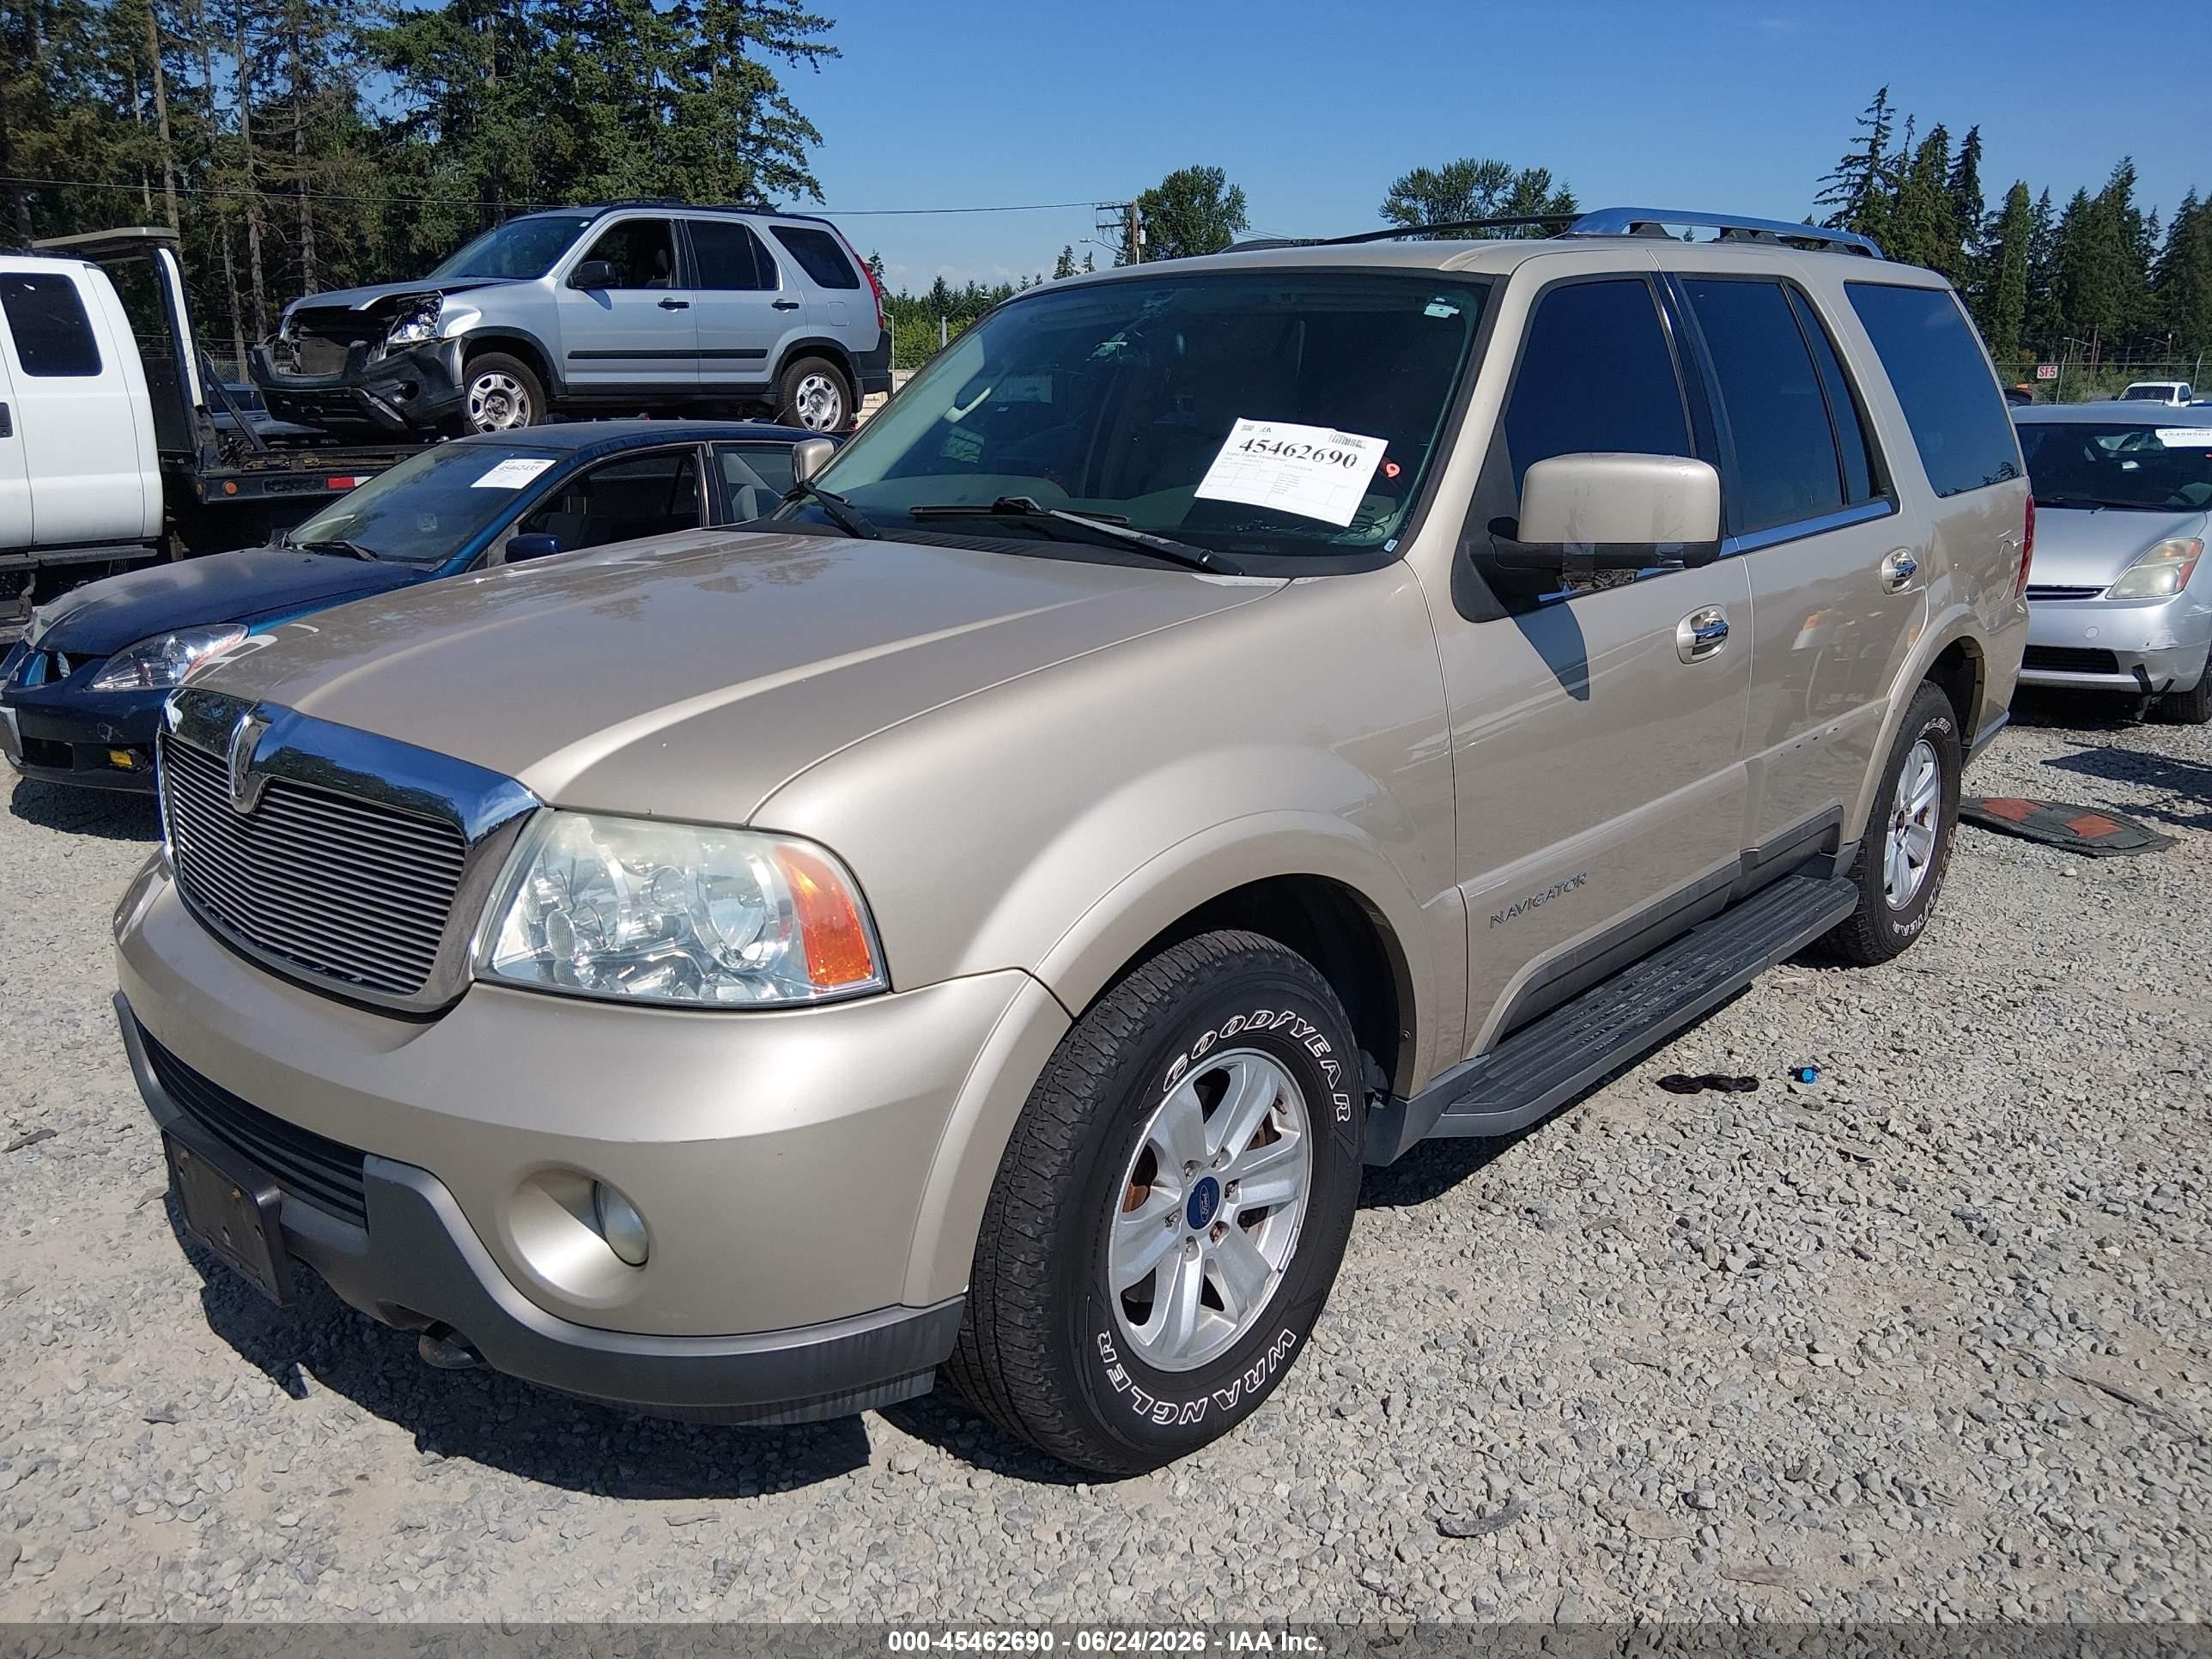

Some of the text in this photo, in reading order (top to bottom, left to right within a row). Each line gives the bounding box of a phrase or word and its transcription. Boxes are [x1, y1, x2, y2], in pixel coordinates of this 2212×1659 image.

[2039, 367, 2057, 377] SF5
[1238, 438, 1358, 469] 45462690
[1490, 872, 1587, 929] NAVIGATOR
[1163, 1010, 1351, 1122] GOODYEAR
[1097, 1328, 1297, 1425] WRANGLER
